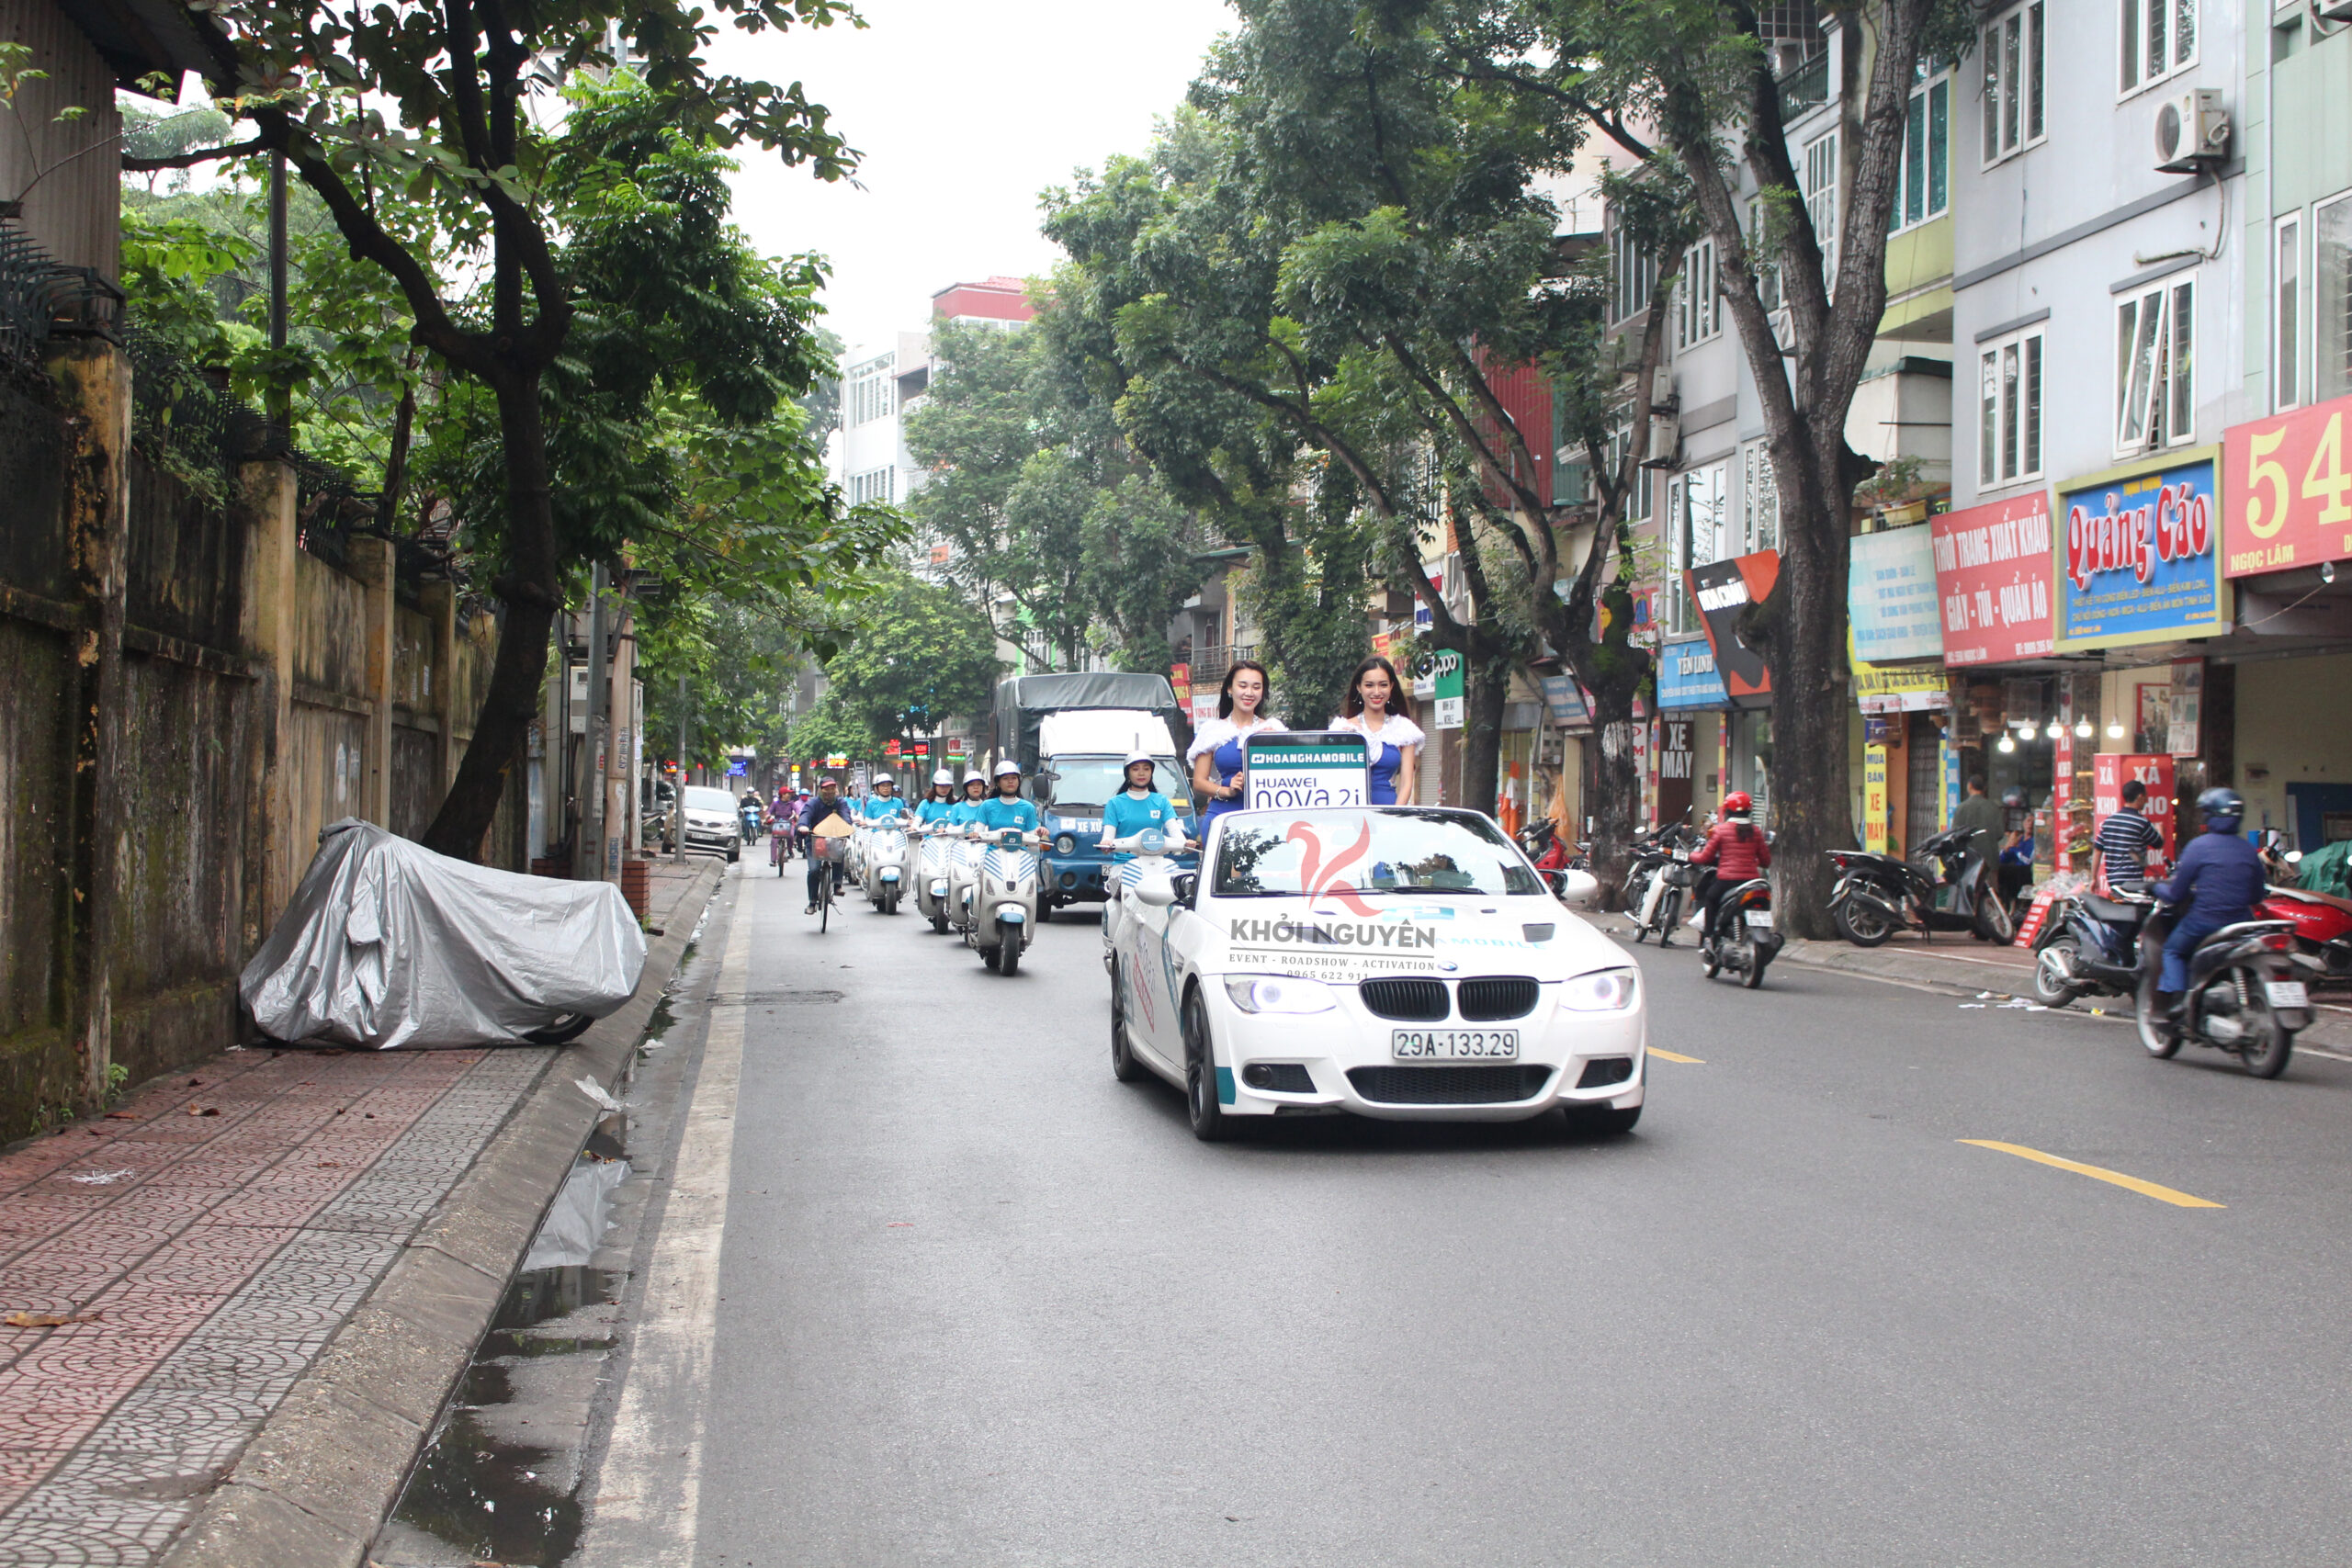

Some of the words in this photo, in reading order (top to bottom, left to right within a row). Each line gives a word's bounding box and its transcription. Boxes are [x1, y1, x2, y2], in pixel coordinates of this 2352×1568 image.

[1933, 525, 1956, 572] THỜI
[1956, 526, 1990, 569] TRANG
[1989, 507, 2018, 562] XUẤT
[2018, 499, 2049, 557] KHẨU
[2066, 492, 2154, 592] Quảng
[2155, 481, 2214, 563] Cáo
[2230, 550, 2264, 573] NGỌC
[2267, 543, 2294, 566] LÂM
[1975, 582, 1994, 627] TÚI
[1999, 571, 2031, 628] QUẦN
[2032, 573, 2048, 620] ÁO
[1678, 647, 1693, 676] YẾN
[1694, 654, 1714, 674] LINH
[1668, 723, 1687, 750] XE
[1265, 752, 1364, 763] HOANGHAMOBILE
[1662, 750, 1693, 779] MAY
[1866, 753, 1885, 764] MUA
[1867, 771, 1884, 783] BÁN
[2098, 759, 2114, 785] XẢ
[2133, 758, 2161, 784] XẢ
[1255, 777, 1317, 788] HUAWEI
[1256, 789, 1329, 808] nova
[1339, 788, 1359, 807] 2i
[1870, 793, 1881, 811] XE
[2097, 796, 2118, 815] KHO
[2142, 796, 2168, 815] HO
[1077, 821, 1089, 833] XE
[1866, 819, 1884, 840] MÁY
[1397, 1032, 1515, 1056] 29A-133.29
